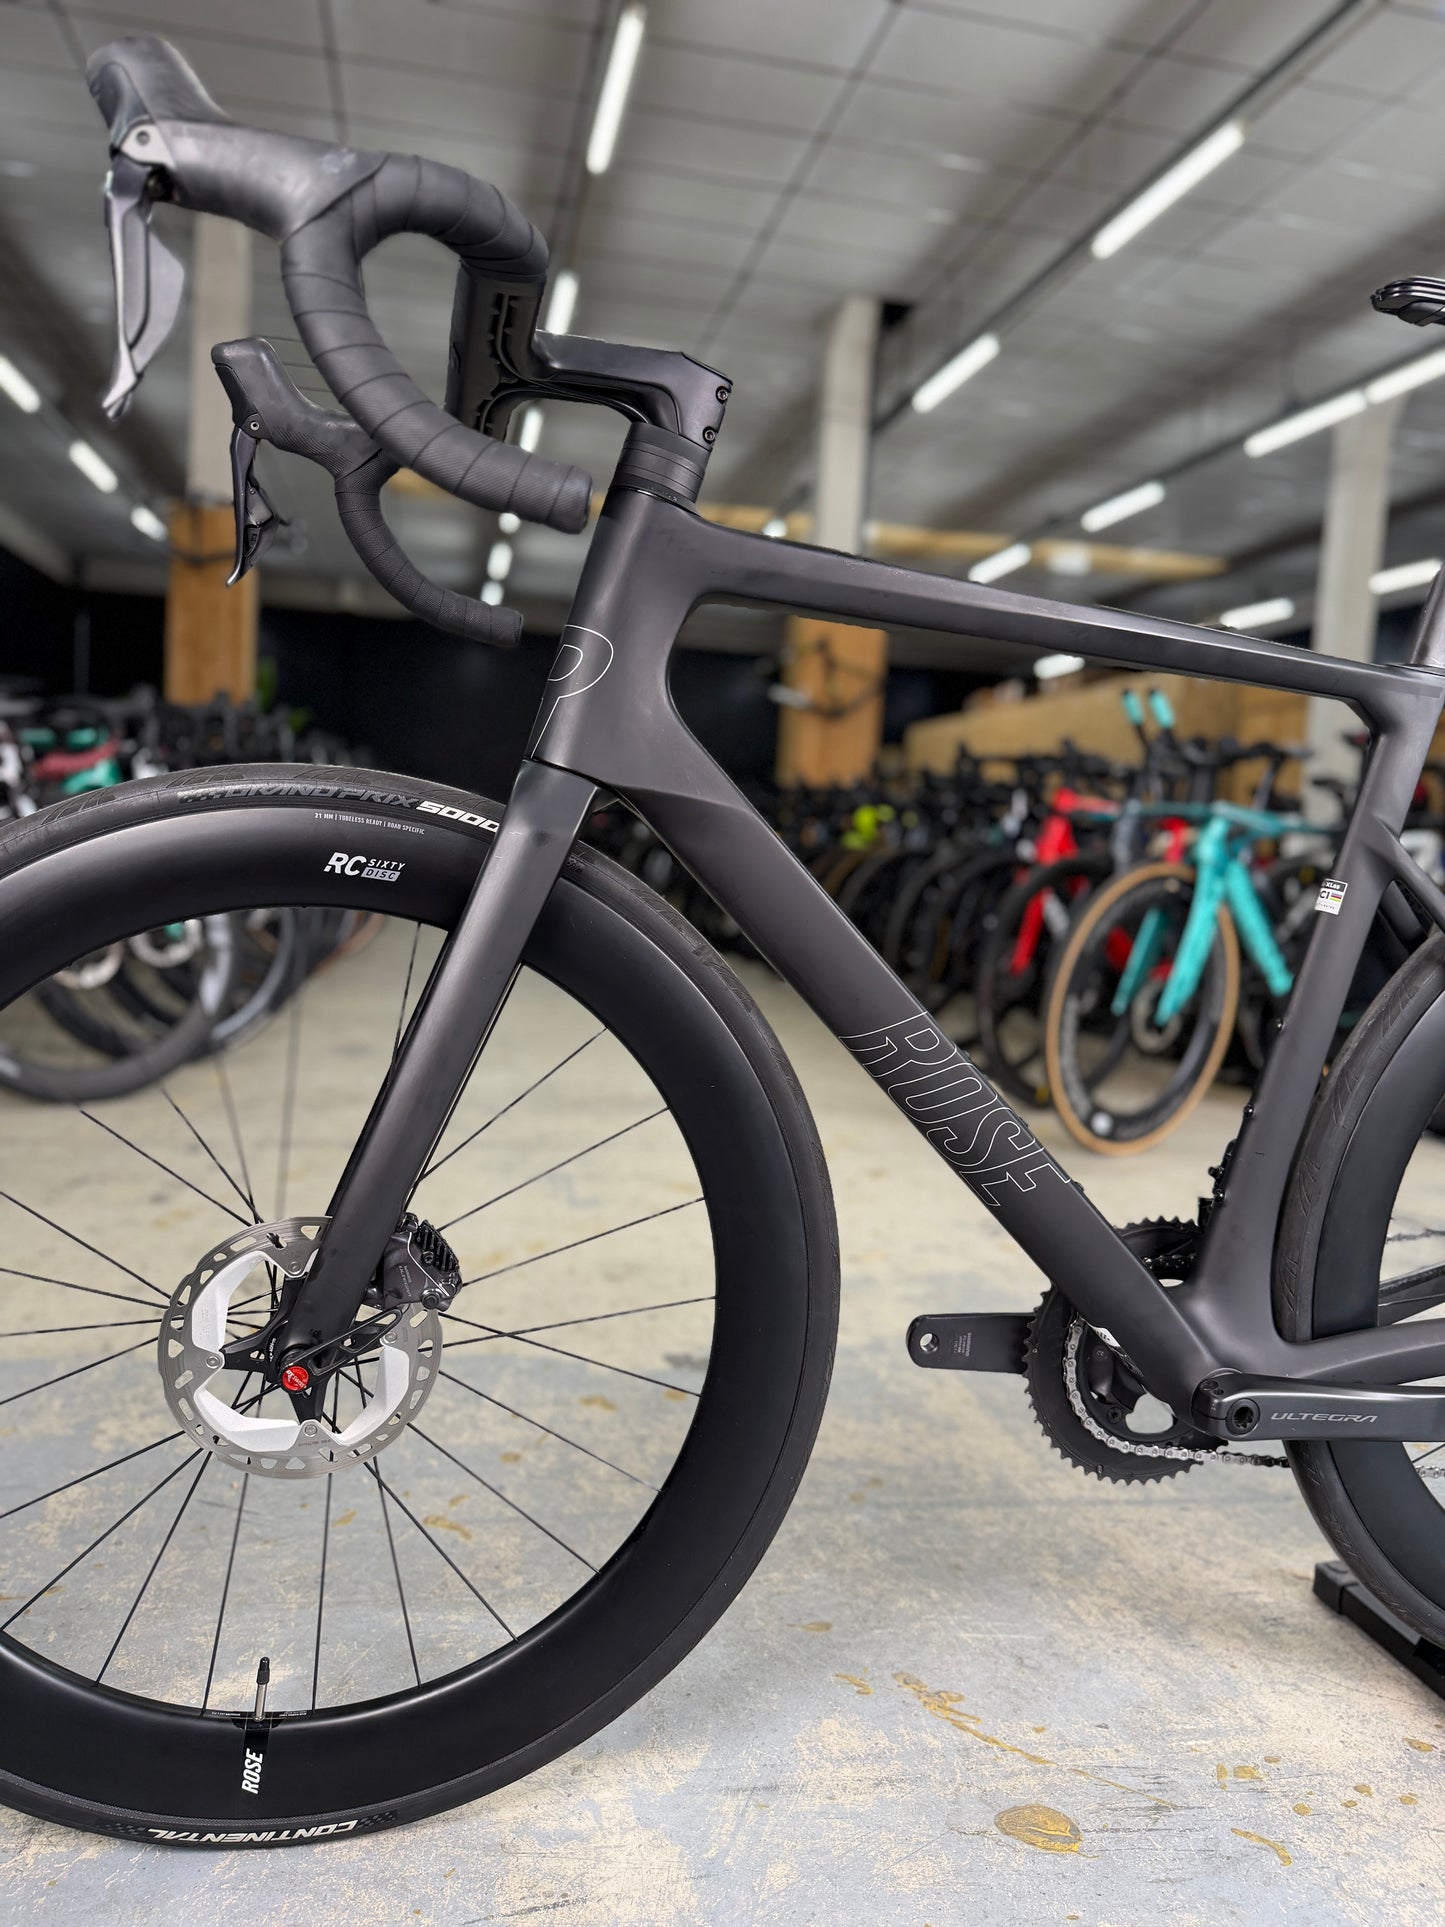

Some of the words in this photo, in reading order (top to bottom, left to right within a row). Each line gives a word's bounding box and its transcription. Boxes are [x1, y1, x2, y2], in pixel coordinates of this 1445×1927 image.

[337, 787, 419, 808] PRIX
[415, 800, 500, 833] 5000
[338, 814, 365, 824] TUBELESS
[365, 818, 383, 827] READY
[387, 822, 401, 830] ROAD
[402, 825, 425, 835] SPECIFIC
[323, 852, 367, 876] RC
[365, 869, 396, 880] DISC
[367, 858, 406, 871] SIXTY
[1320, 890, 1330, 899] CI
[839, 1011, 1072, 1207] ROSE
[1270, 1412, 1378, 1423] ULTEGRA
[241, 1748, 264, 1795] ROSE
[147, 1819, 359, 1844] CONTINENTAL
